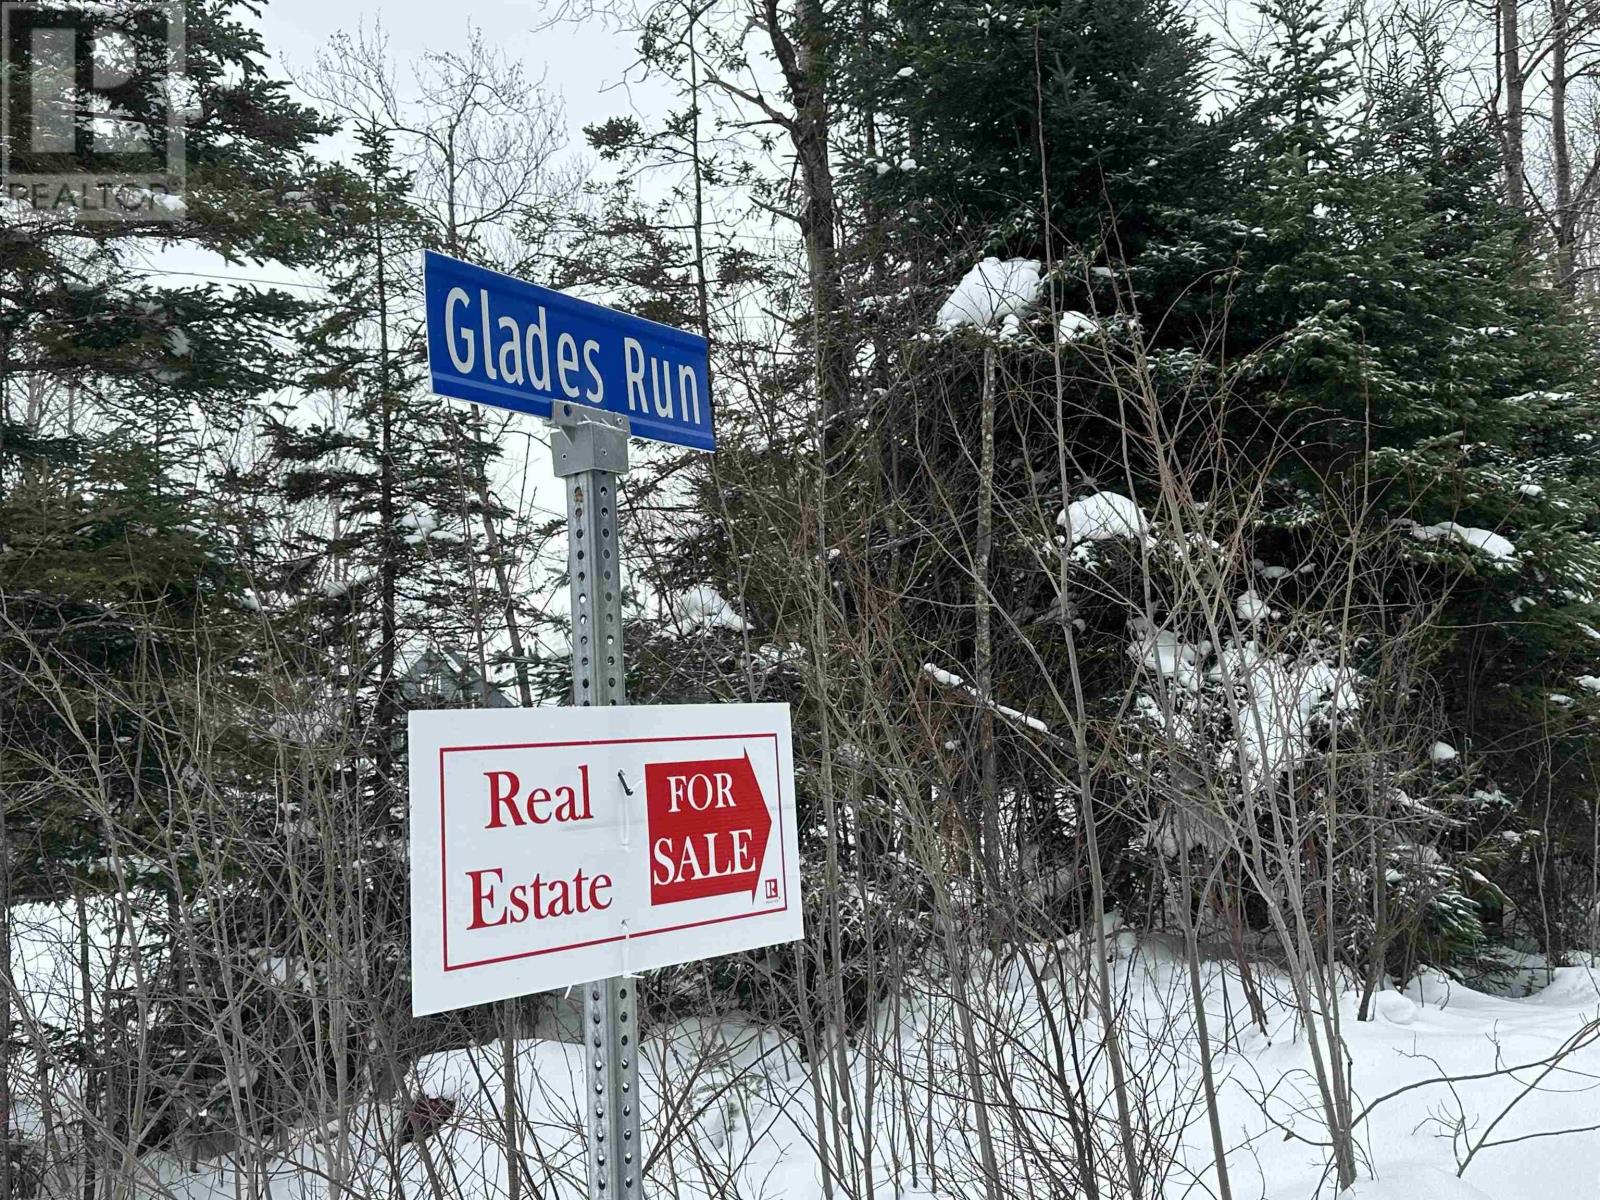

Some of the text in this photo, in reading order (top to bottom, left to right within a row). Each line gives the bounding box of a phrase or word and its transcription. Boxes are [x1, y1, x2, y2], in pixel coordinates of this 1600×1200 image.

[445, 286, 701, 425] Glades Run
[483, 765, 594, 829] Real
[667, 773, 737, 813] FOR
[653, 829, 756, 886] SALE
[465, 867, 613, 930] Estate
